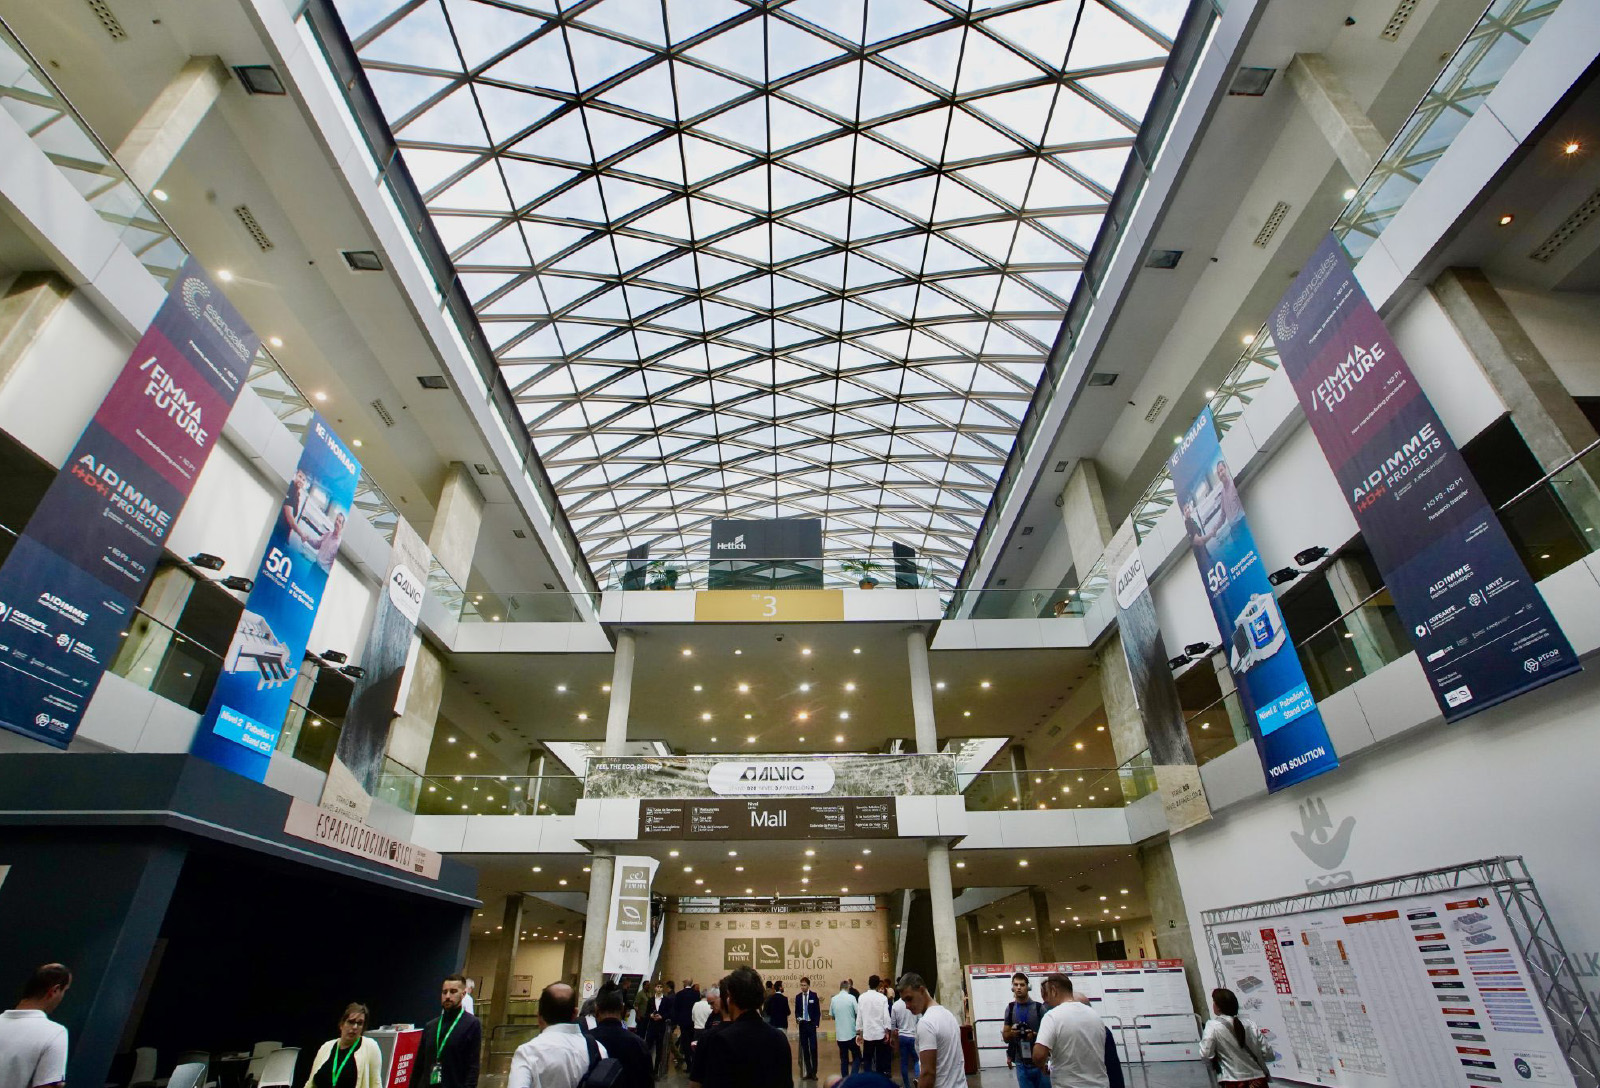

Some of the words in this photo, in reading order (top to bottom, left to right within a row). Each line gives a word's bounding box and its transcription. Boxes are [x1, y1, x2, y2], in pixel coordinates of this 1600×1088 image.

[1325, 342, 1385, 412] FUTURE
[144, 380, 208, 448] FUTURE
[1180, 414, 1208, 456] HOMAG
[327, 436, 356, 475] HOMAG
[1353, 422, 1435, 503] AIDIMME
[1386, 437, 1441, 489] PROJECTS
[79, 454, 171, 528] AIDIMME
[109, 492, 164, 538] PROJECTS
[717, 542, 747, 550] Hettich
[266, 547, 292, 578] 50
[1207, 561, 1227, 591] 50
[1429, 563, 1471, 595] AIDIMME
[40, 592, 90, 621] AIDIMME
[762, 595, 777, 617] 3
[1259, 707, 1274, 720] Nivel
[1283, 705, 1301, 719] Stand
[1300, 698, 1313, 710] C21
[758, 766, 805, 781] ALVIC
[1268, 762, 1289, 778] YOUR
[1288, 746, 1326, 769] SOLUTION
[751, 809, 787, 827] Mall
[787, 938, 820, 959] 40ª
